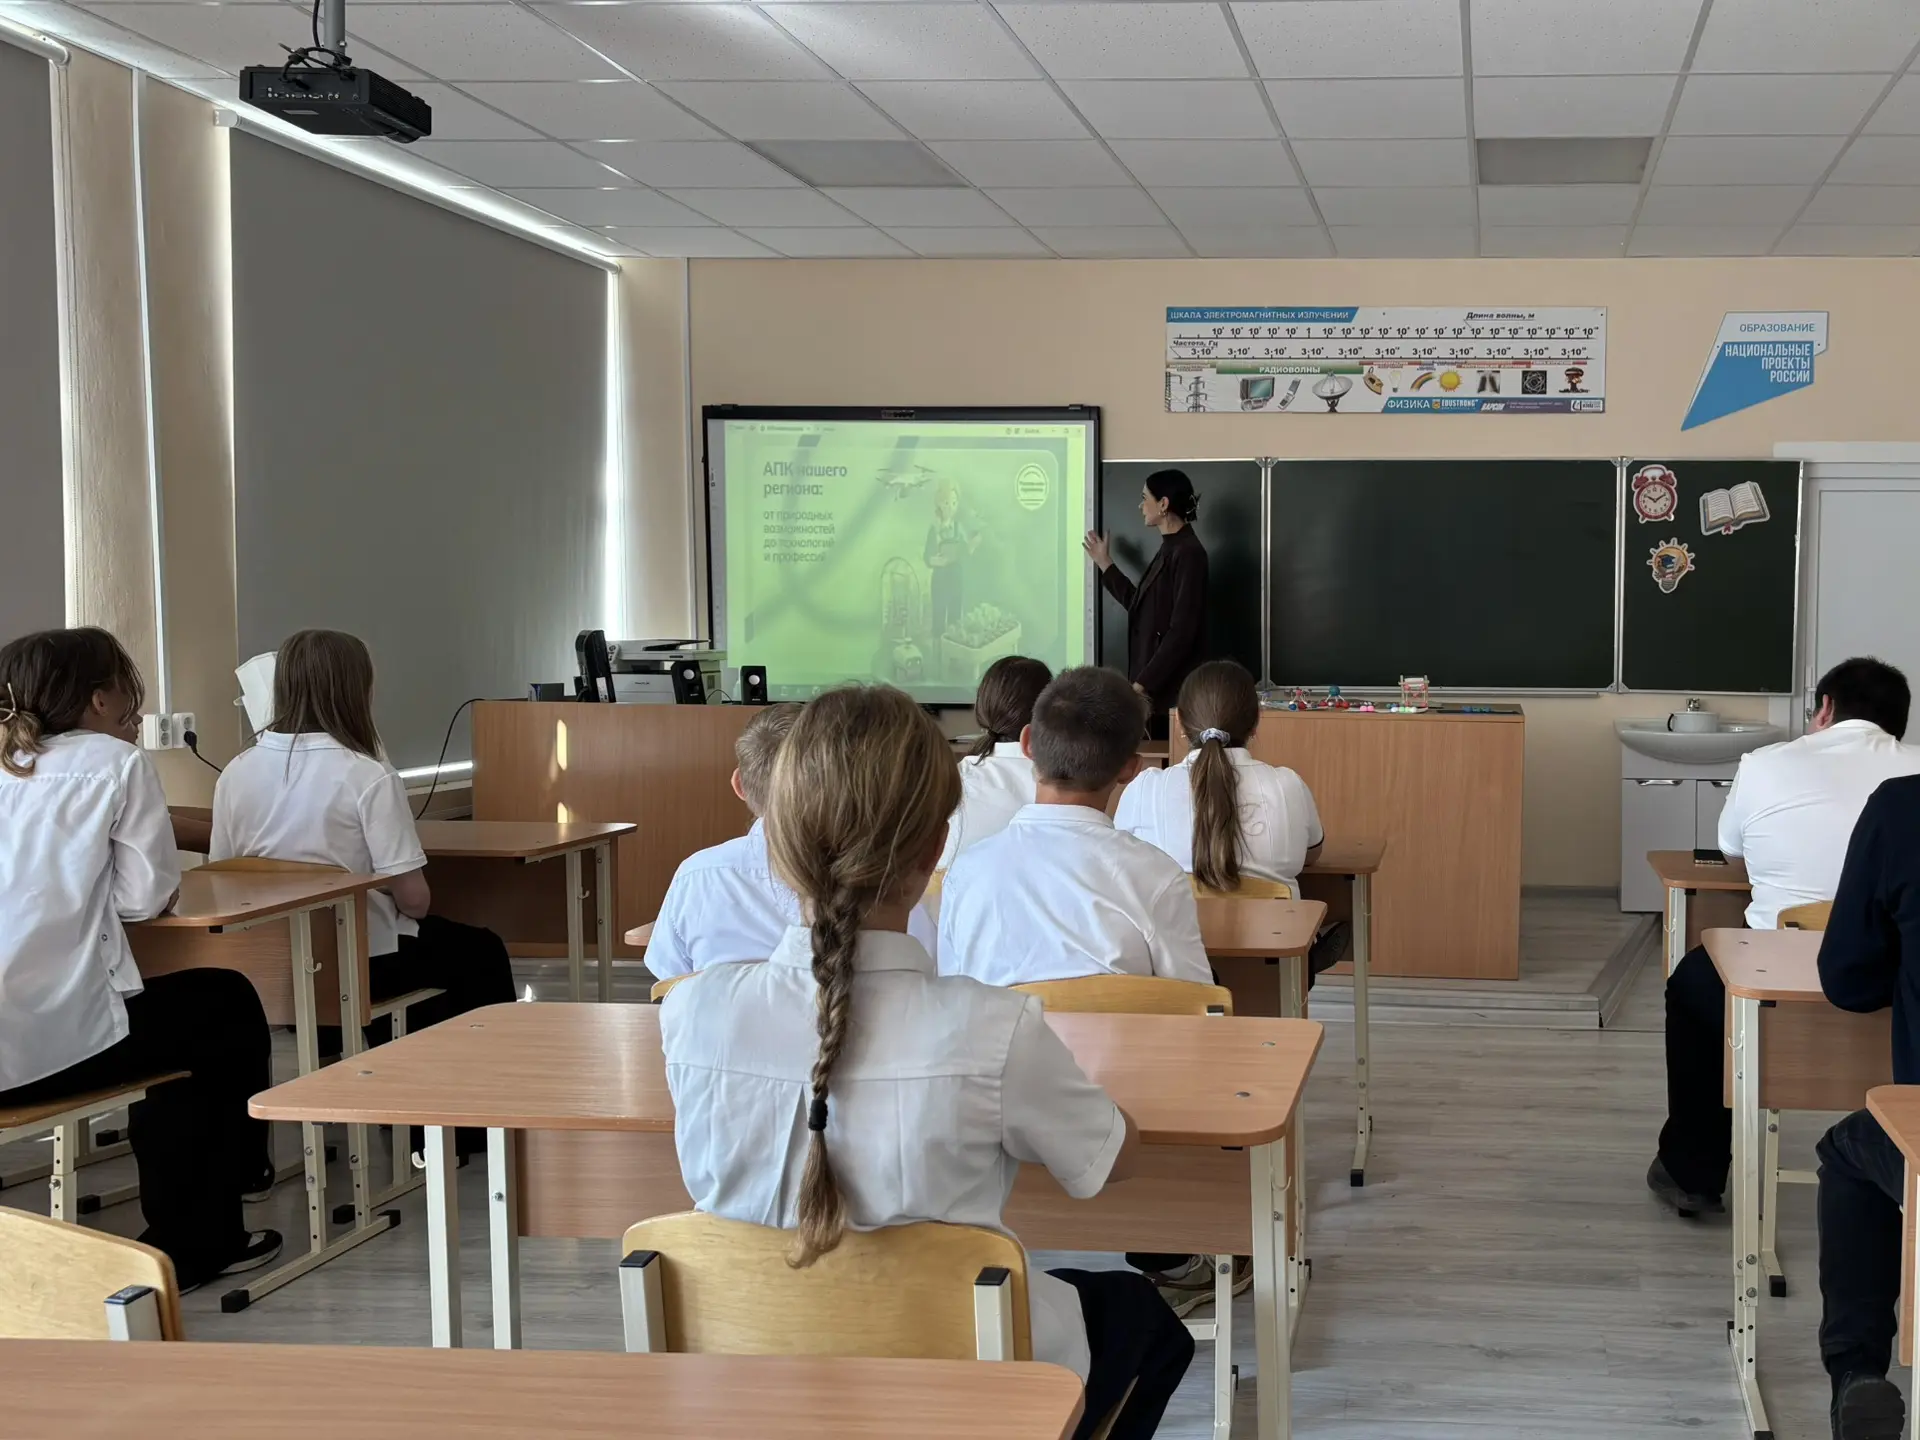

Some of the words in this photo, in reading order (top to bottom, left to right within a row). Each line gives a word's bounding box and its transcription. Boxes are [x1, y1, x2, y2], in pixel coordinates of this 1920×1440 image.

[1170, 311, 1201, 319] ШКАЛА
[1203, 311, 1296, 319] ЭЛЕКТРОМАГНИТНЫХ
[1466, 311, 1494, 320] Длина
[1740, 323, 1816, 332] ОБРАЗОВАНИЕ
[1725, 344, 1811, 358] НАЦИОНАЛЬНЫЕ
[1761, 357, 1810, 370] ПРОЕКТЫ
[1259, 366, 1321, 374] РАДИОВОЛНЫ
[1770, 370, 1810, 382] РОССИИ
[1387, 400, 1430, 409] ФИЗИКА
[763, 461, 794, 477] АПК
[763, 482, 824, 498] региона:
